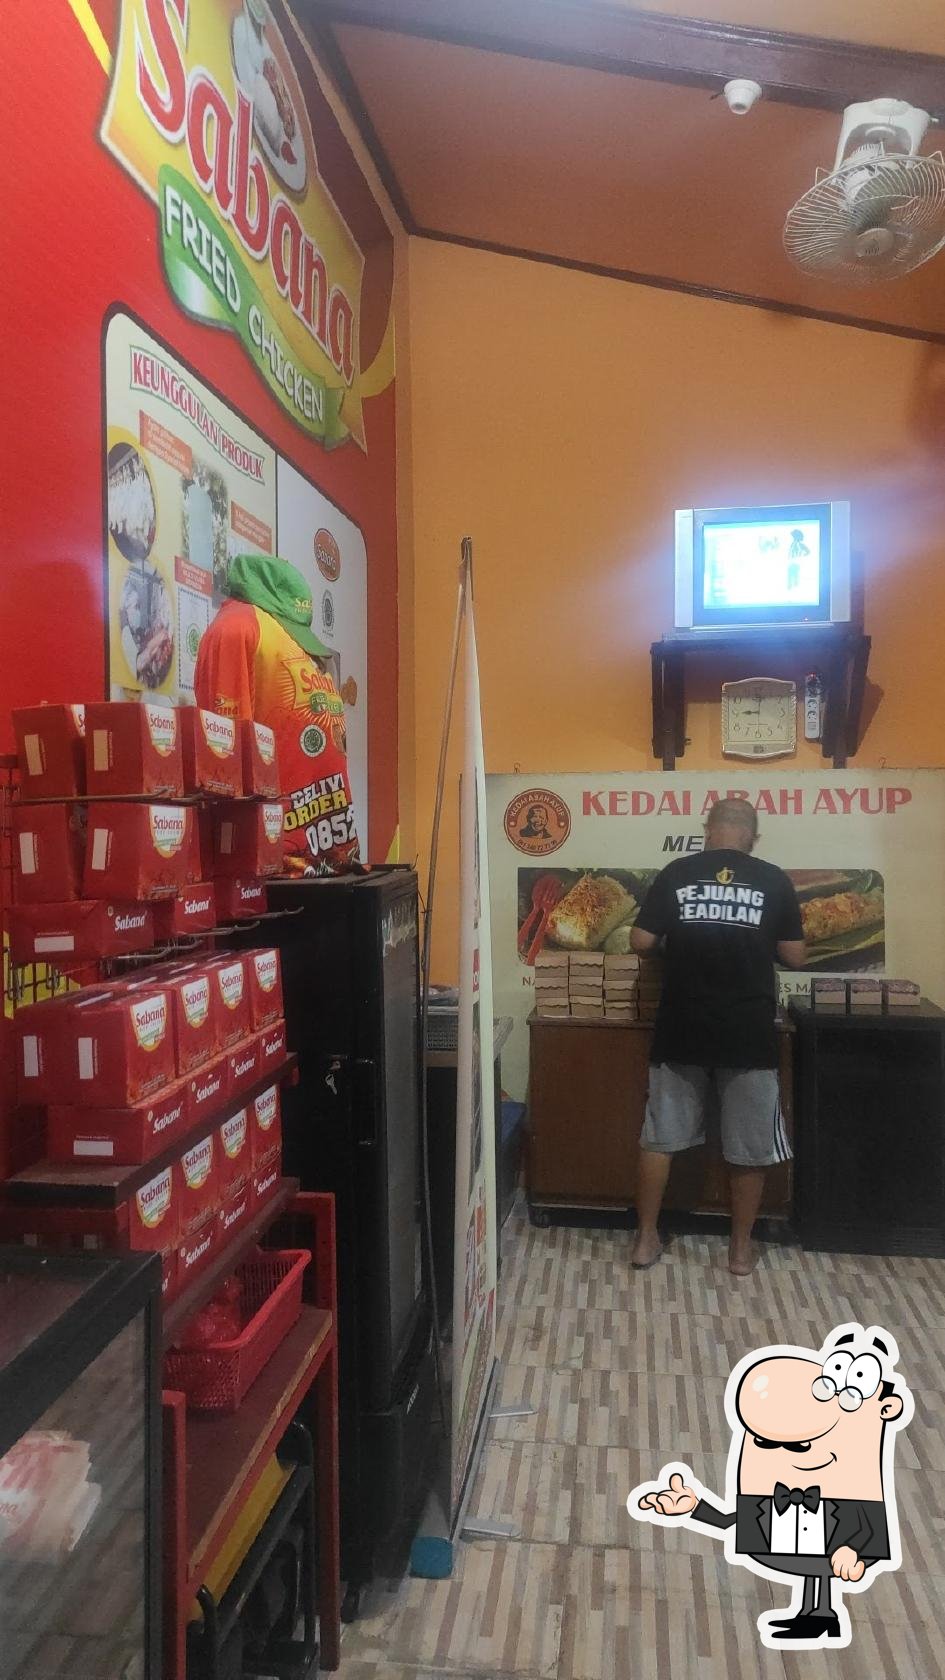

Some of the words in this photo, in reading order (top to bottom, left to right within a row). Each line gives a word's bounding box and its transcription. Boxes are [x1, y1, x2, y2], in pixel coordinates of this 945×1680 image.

[136, 0, 358, 386] Sabana
[164, 186, 241, 314] FRIED
[247, 305, 325, 424] CHICKEN
[131, 350, 219, 446] KEUNGGULAN
[221, 435, 263, 480] PRODUK
[283, 789, 348, 831] ORDER
[582, 790, 692, 816] KEDAI
[812, 787, 913, 816] AYUP
[153, 815, 184, 830] Sabana
[240, 886, 262, 900] Sabana
[675, 884, 765, 907] PEJUANG
[184, 899, 209, 915] Sabana
[114, 914, 146, 932] Sabana
[135, 1006, 165, 1027] Sabana
[196, 1079, 220, 1104] Sabana
[153, 1107, 181, 1134] Sabana
[184, 1143, 211, 1167] Sabana
[141, 1177, 171, 1204] Sabana
